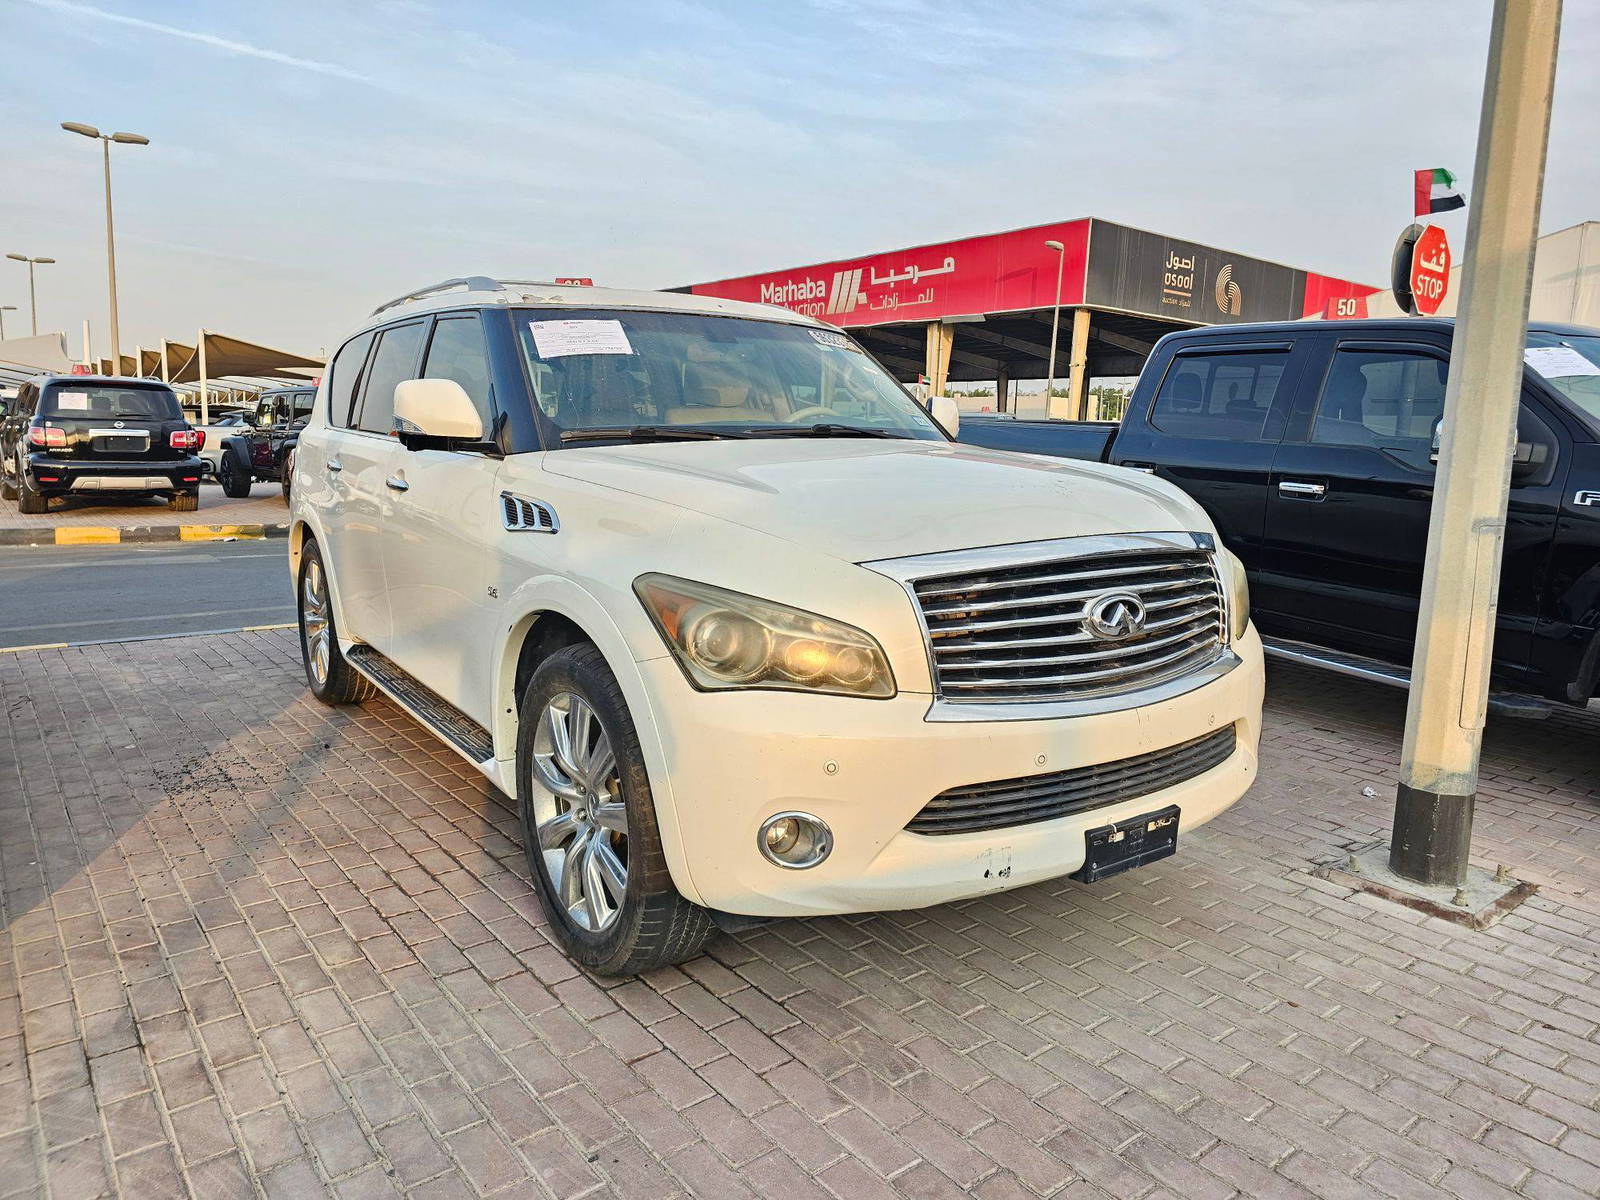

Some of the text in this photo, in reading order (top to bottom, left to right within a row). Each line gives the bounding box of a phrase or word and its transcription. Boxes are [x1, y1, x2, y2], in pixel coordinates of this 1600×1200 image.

[1420, 242, 1446, 273] قف
[870, 257, 955, 288] مرحبا
[760, 276, 826, 304] Marhaba
[1416, 275, 1443, 300] STOP
[1337, 298, 1356, 316] 50
